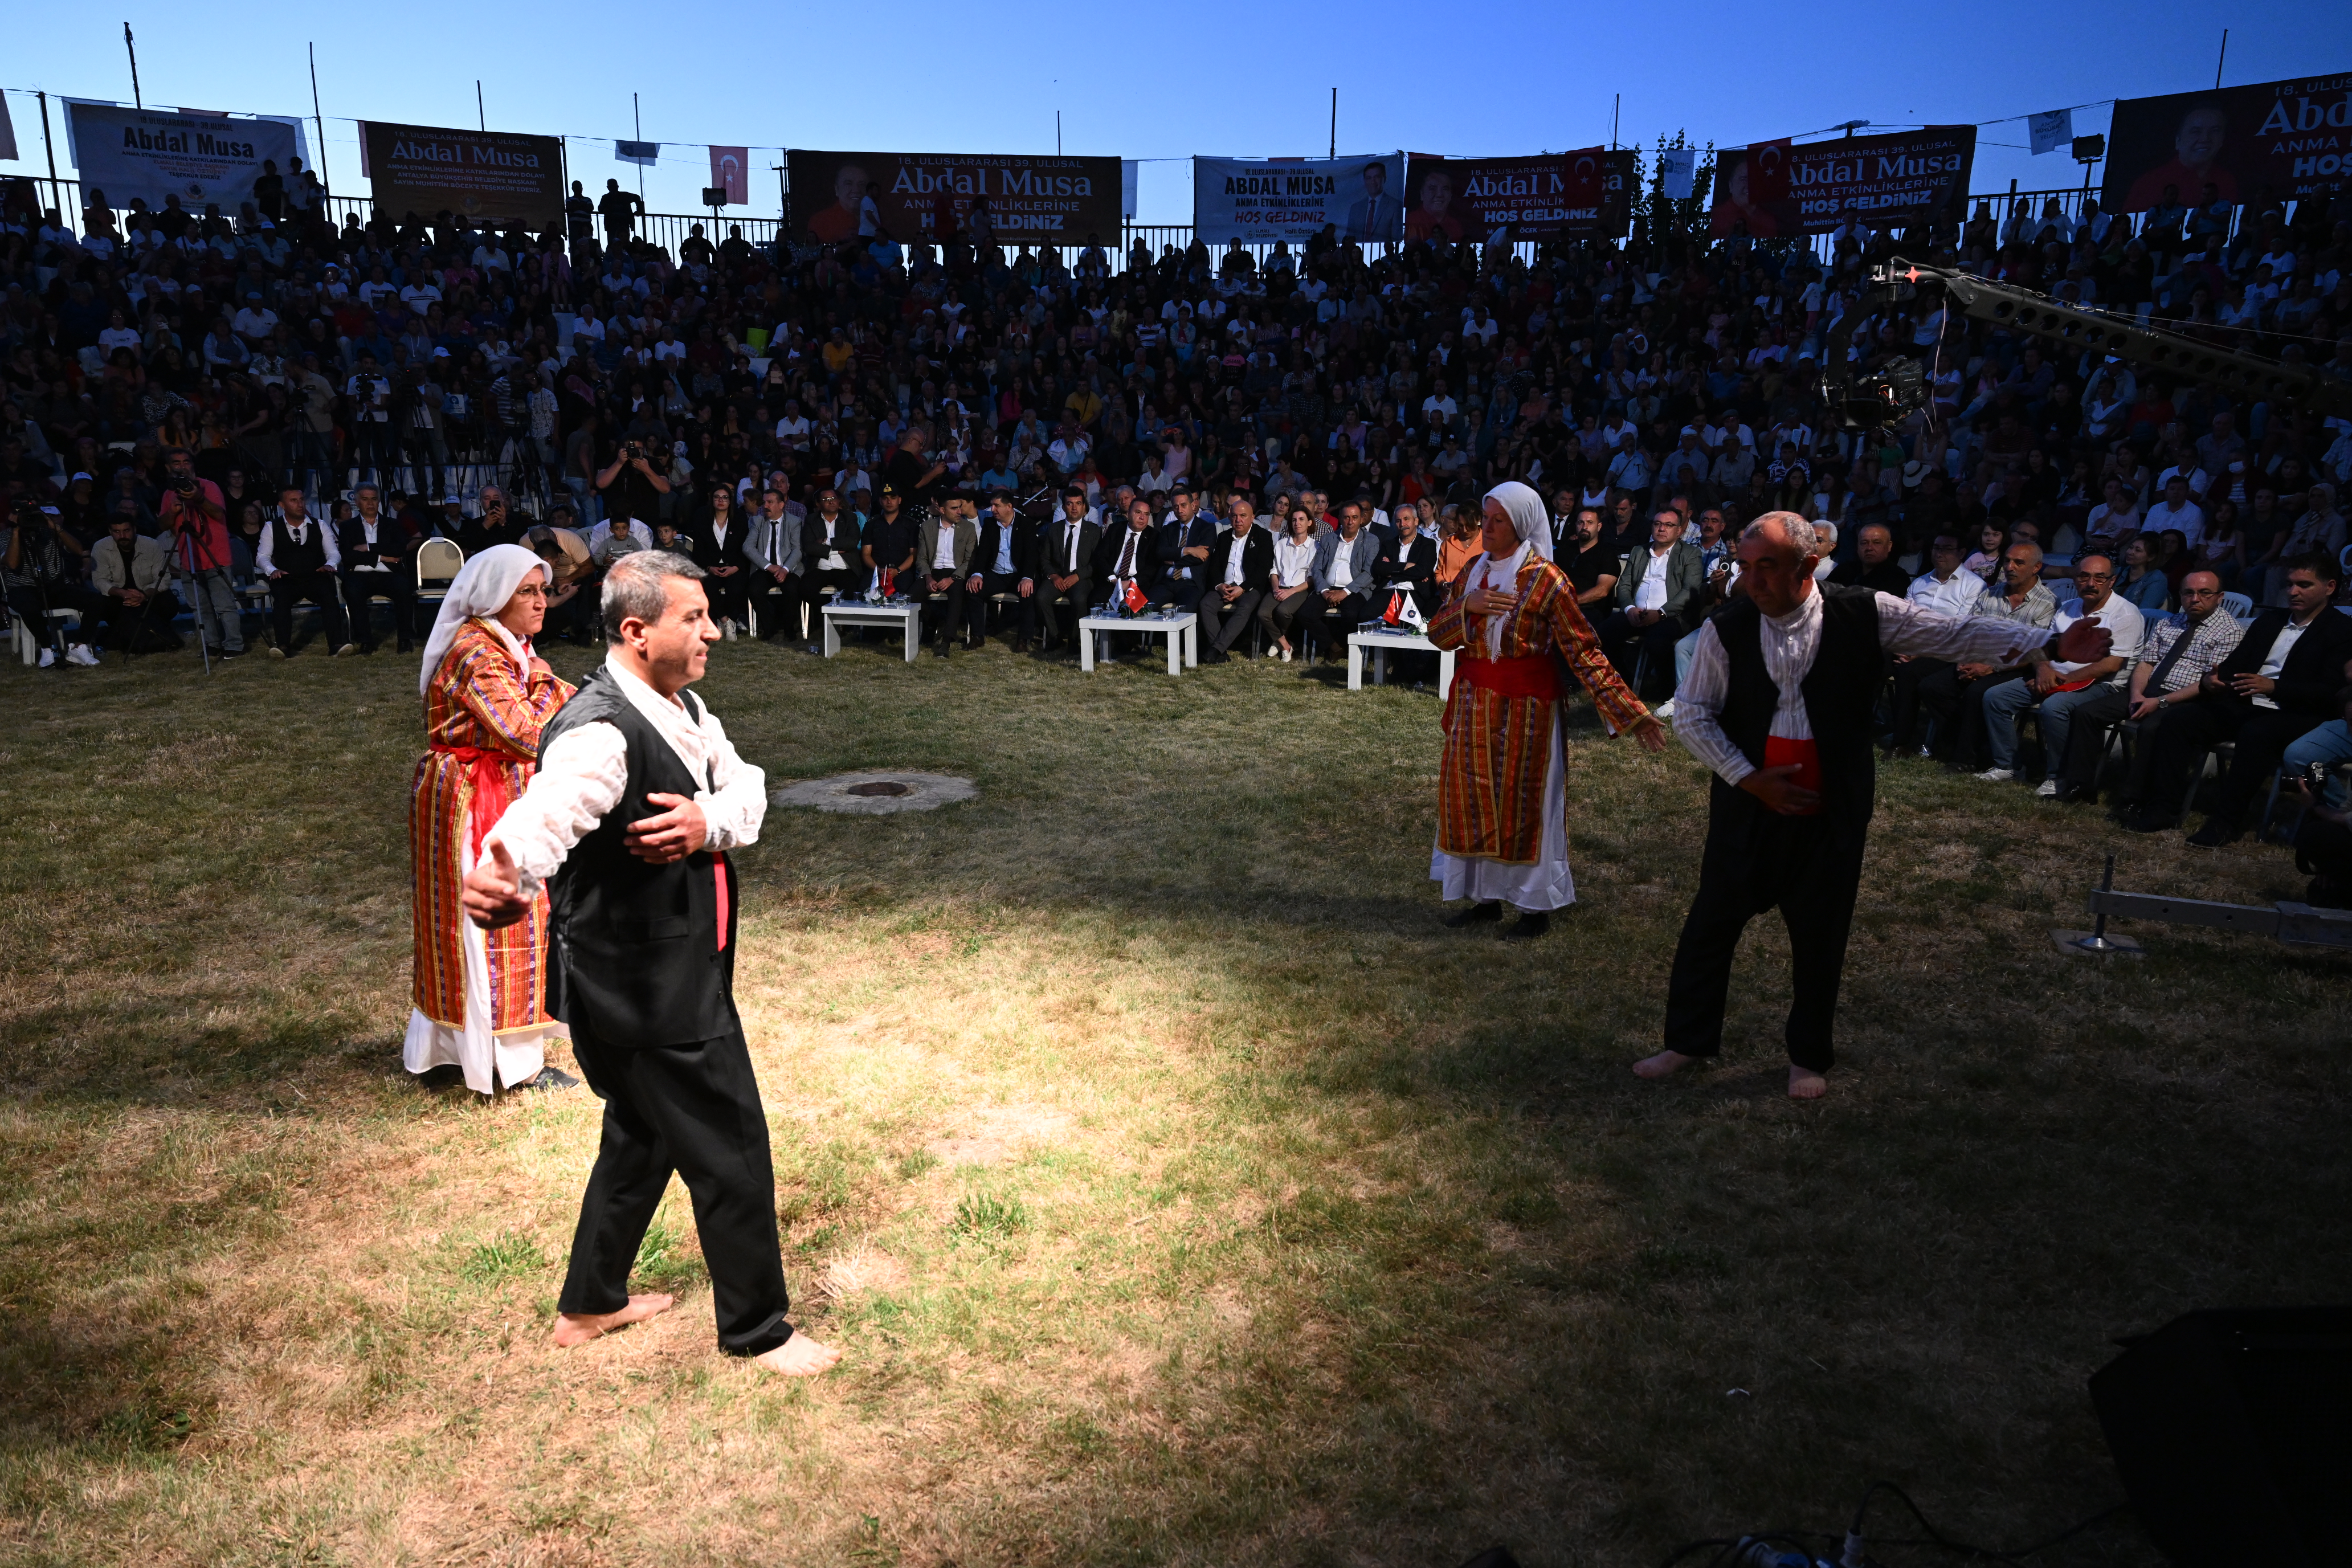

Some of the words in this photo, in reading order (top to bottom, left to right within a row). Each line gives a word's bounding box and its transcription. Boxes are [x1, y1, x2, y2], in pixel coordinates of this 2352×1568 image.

[2275, 85, 2298, 97] 18.
[124, 126, 189, 153] Abdal
[197, 133, 254, 158] Musa
[411, 132, 479, 143] ULUSLARARASI
[2271, 136, 2339, 154] ANMA
[141, 152, 188, 162] ETKİNLİKLERİNE
[390, 140, 464, 163] Abdal
[472, 146, 540, 168] Musa
[1805, 148, 1888, 162] ULUSLARARASI
[1912, 140, 1955, 152] ULUSAL
[919, 157, 1011, 167] ULUSLARARASI
[1036, 160, 1083, 169] ULUSAL
[1487, 165, 1559, 175] ULUSLARARASI
[1877, 153, 1961, 179] Musa
[169, 172, 198, 180] TEŞEKKÜR
[410, 165, 464, 174] ETKİNLİKLERİNE
[466, 168, 519, 177] KATKILARINDAN
[430, 173, 473, 182] BÜYÜKŞEHİR
[890, 166, 989, 195] Abdal
[1001, 169, 1093, 197] Musa
[1224, 177, 1281, 195] ABDAL
[1287, 176, 1336, 194] MUSA
[1463, 174, 1538, 198] Abdal
[1788, 188, 1827, 199] ANMA
[1831, 176, 1949, 196] ETKİNLİKLERİNE
[1235, 198, 1258, 207] ANMA
[1260, 196, 1325, 207] ETKİNLİKLERİNE
[1472, 199, 1506, 209] ANMA
[1800, 198, 1839, 215] HOŞ
[1843, 190, 1932, 210] GELDİNİZ
[1235, 211, 1261, 225] HOŞ
[1264, 210, 1326, 223] GELDİNİZ
[1521, 207, 1598, 222] GELDİNİZ
[1803, 218, 1835, 227] Muhittin
